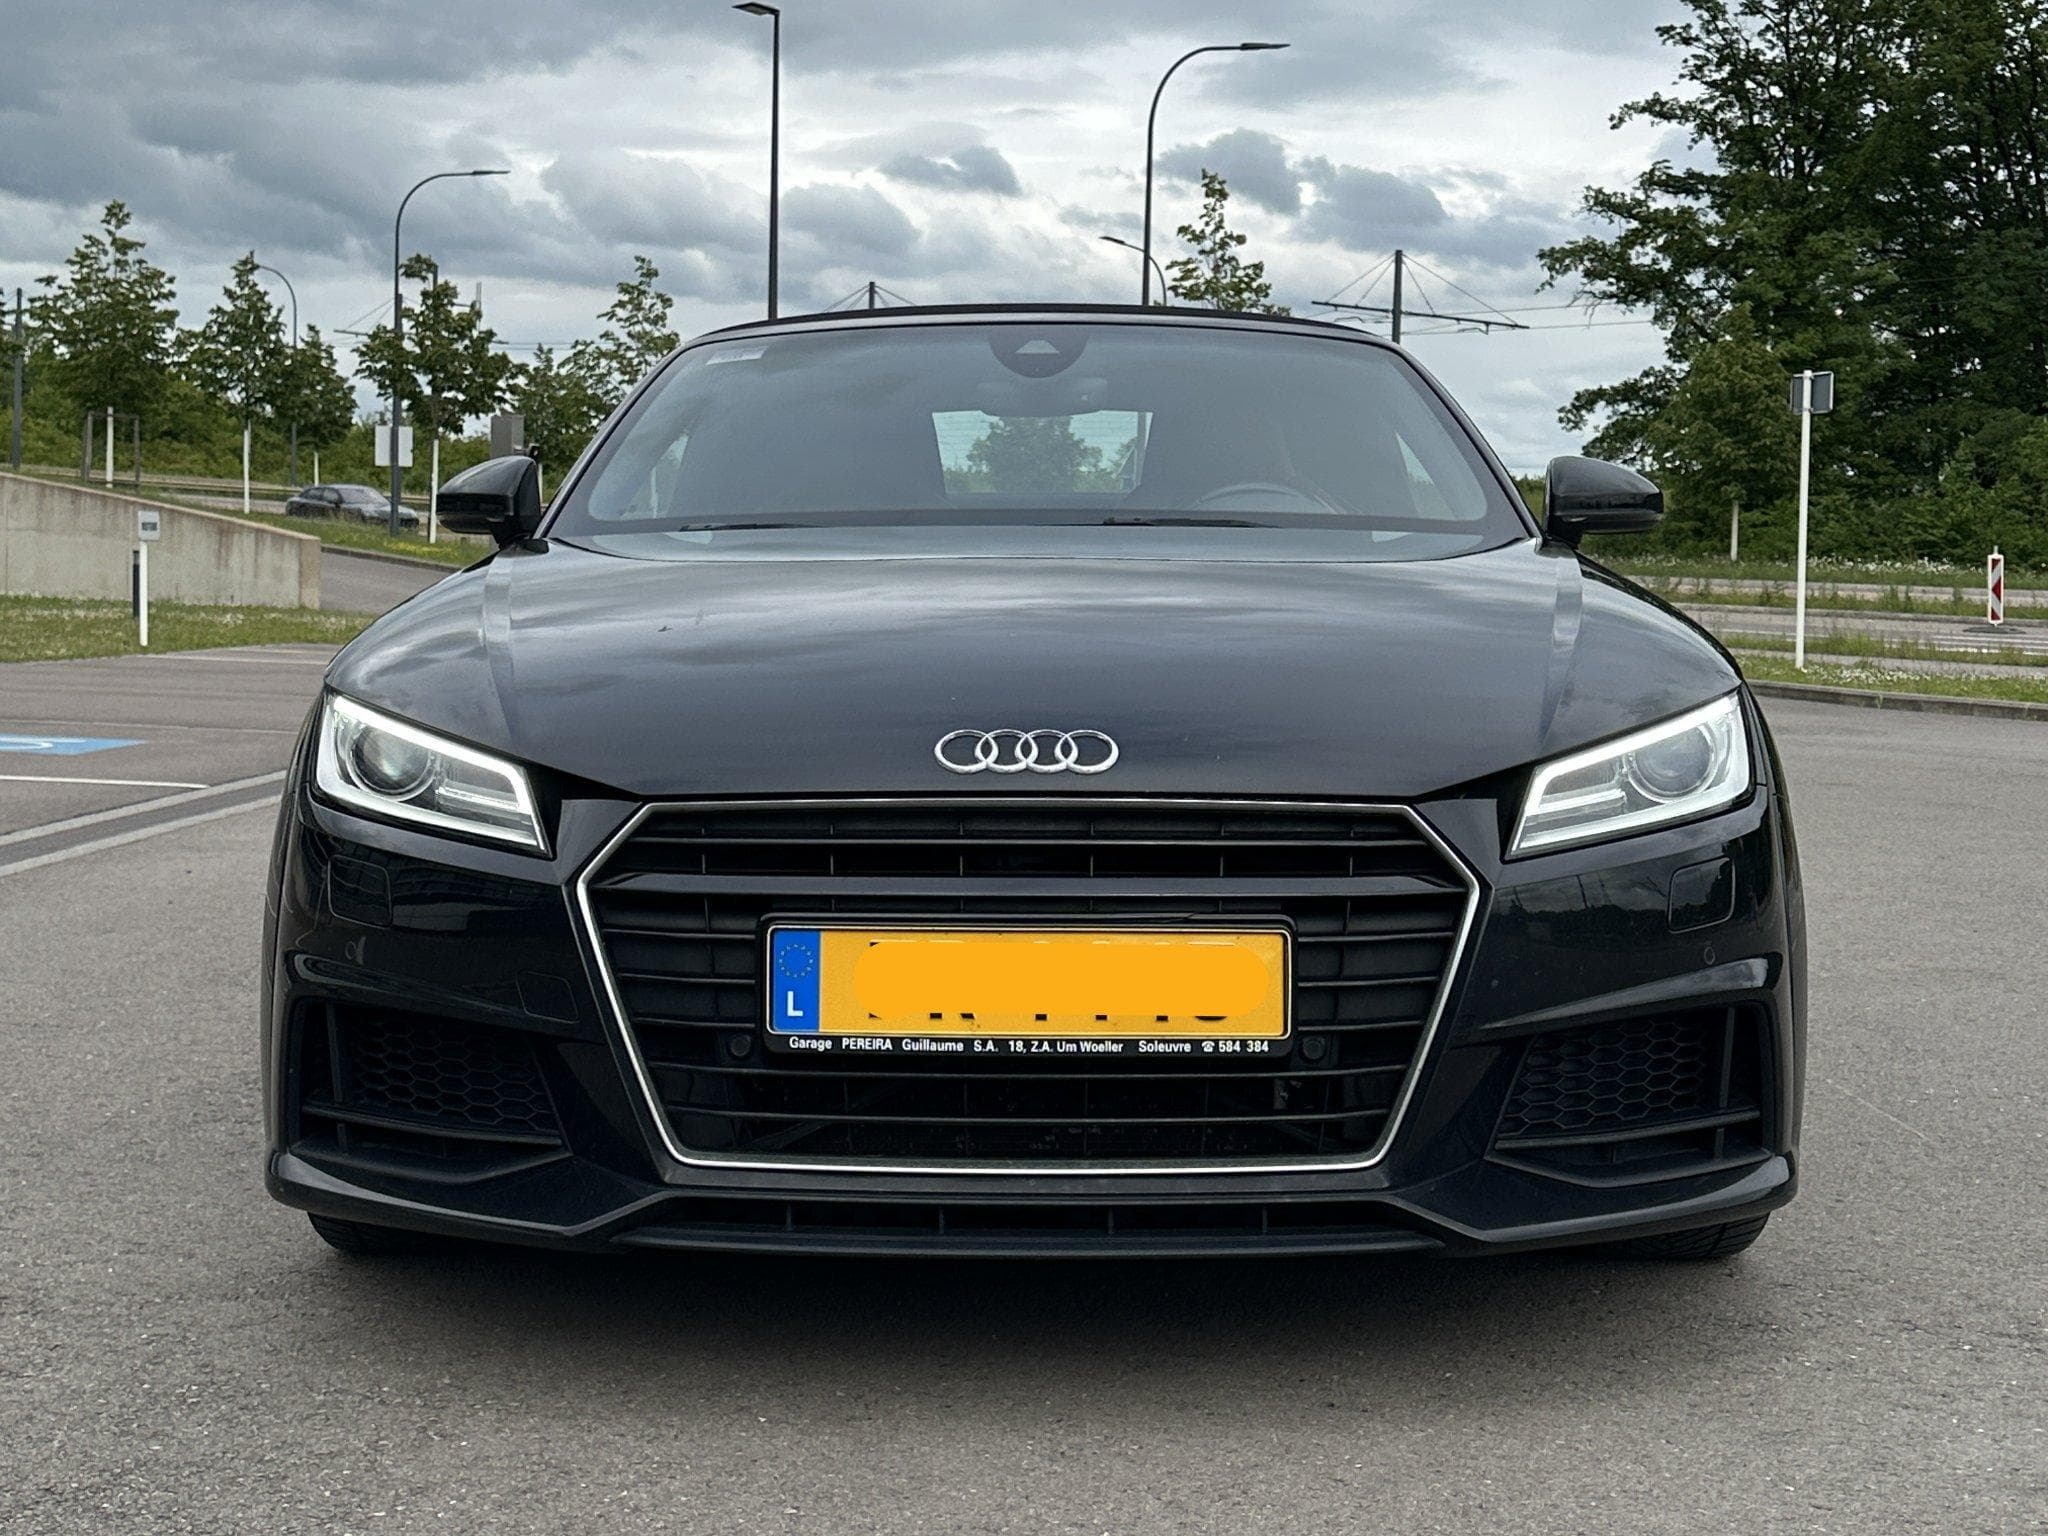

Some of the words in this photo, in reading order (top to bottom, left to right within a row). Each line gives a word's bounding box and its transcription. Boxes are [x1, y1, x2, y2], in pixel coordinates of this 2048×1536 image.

[787, 990, 804, 1017] L
[789, 1036, 833, 1052] Garage
[841, 1037, 893, 1051] PEREIRA
[901, 1038, 964, 1052] Guillaume
[973, 1039, 999, 1052] S.A.
[1056, 1040, 1078, 1053] Um
[1079, 1040, 1124, 1053] Woeller
[1138, 1040, 1192, 1053] Soleuvre
[1218, 1040, 1241, 1053] 584
[1246, 1040, 1269, 1053] 384
